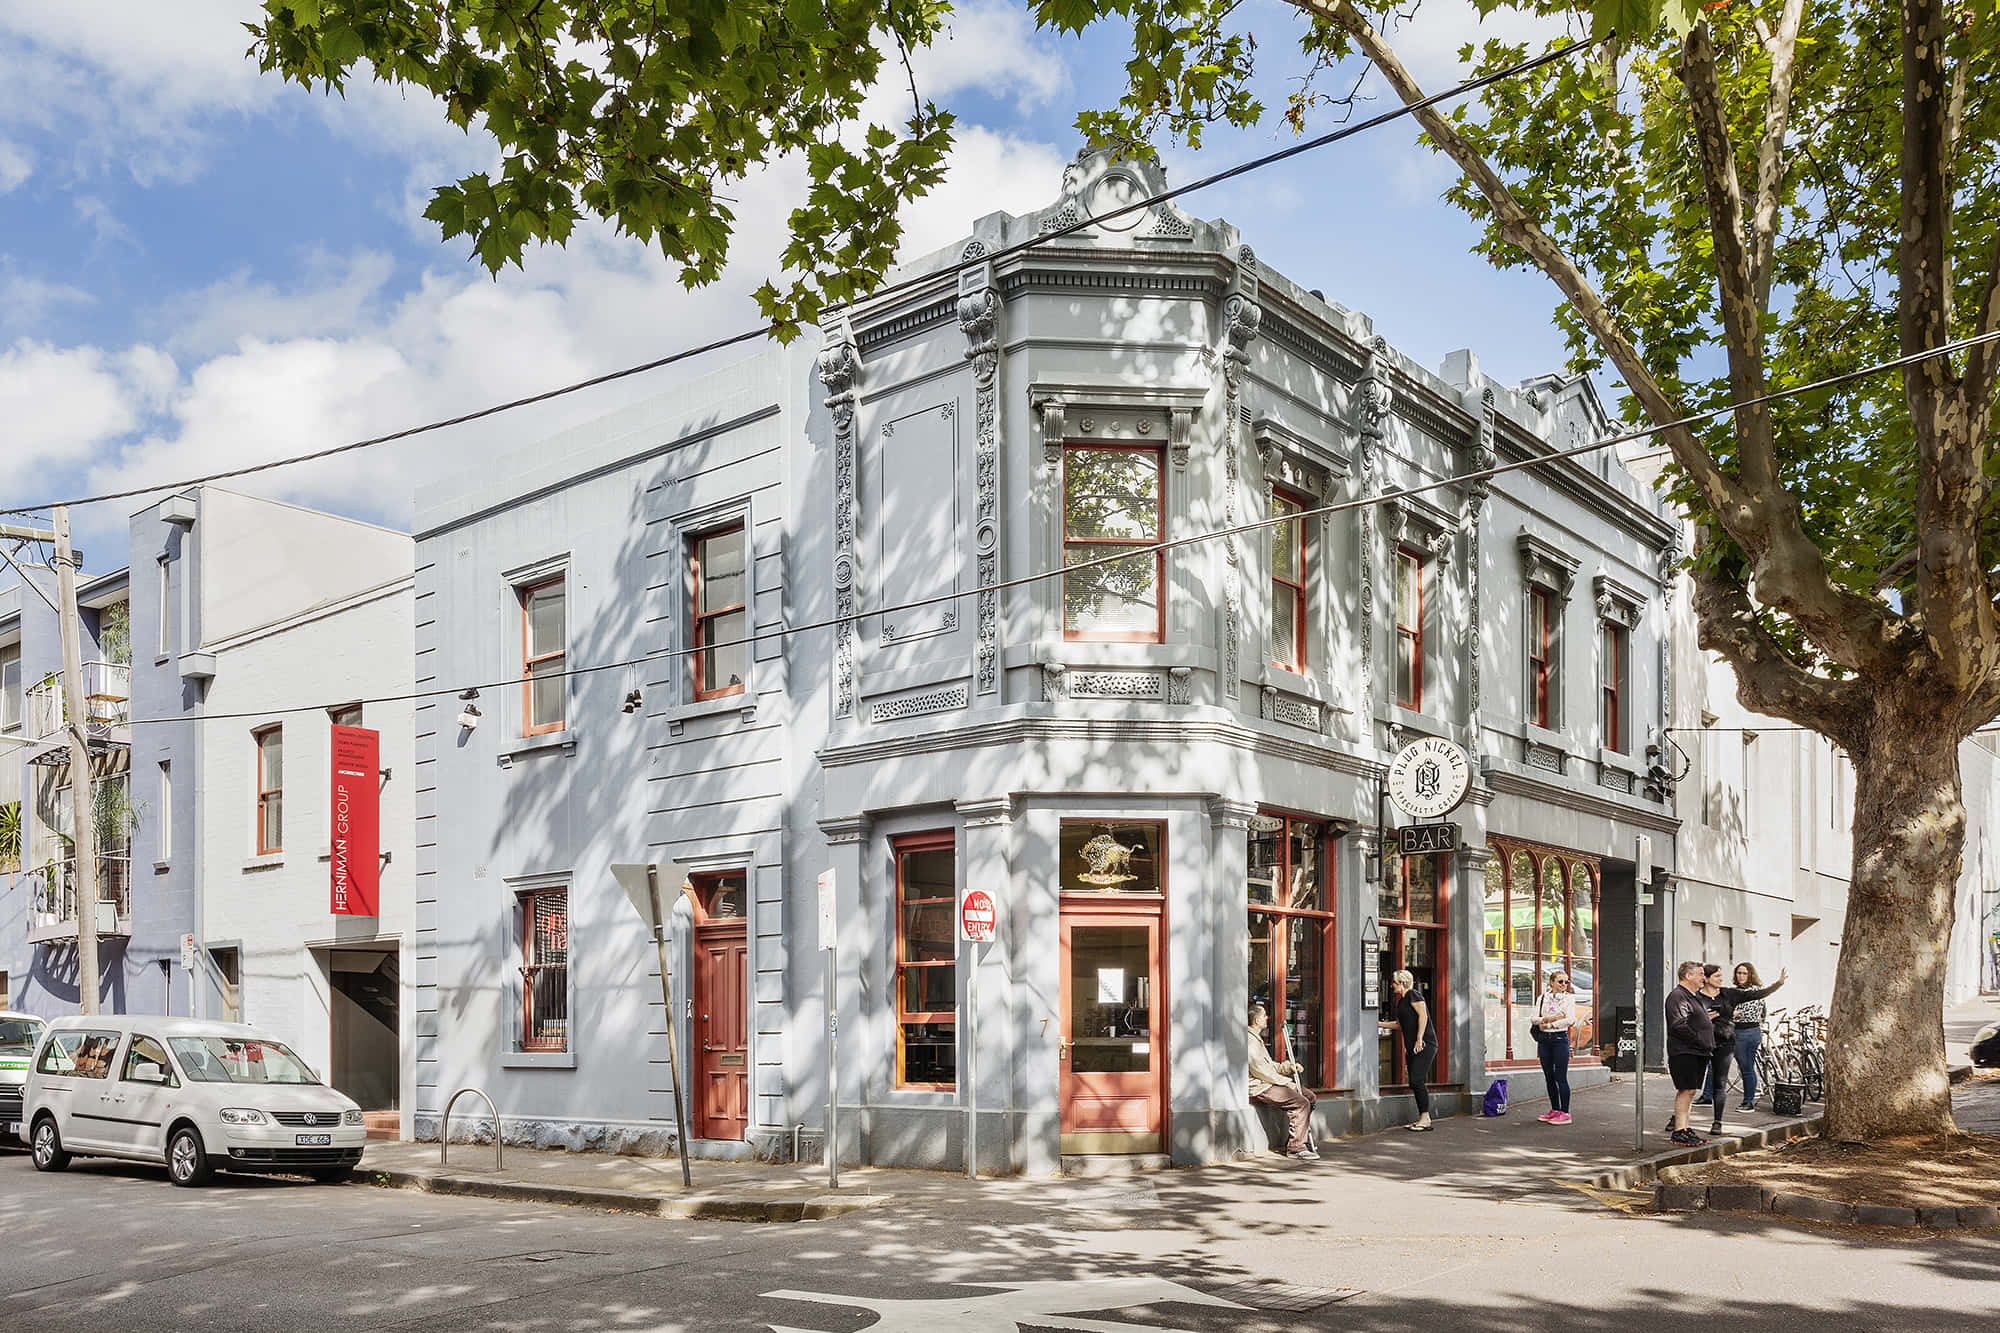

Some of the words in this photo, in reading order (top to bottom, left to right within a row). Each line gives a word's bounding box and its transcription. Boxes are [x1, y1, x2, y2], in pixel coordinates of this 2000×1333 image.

[1394, 745, 1419, 776] PLUG
[1424, 741, 1463, 770] NICKEL
[1396, 790, 1434, 814] SPECIALTY
[1438, 784, 1461, 810] COFFEE
[1404, 825, 1451, 851] BAR
[973, 898, 985, 910] NO
[967, 921, 991, 932] ENTRY
[1039, 1019, 1049, 1039] 7
